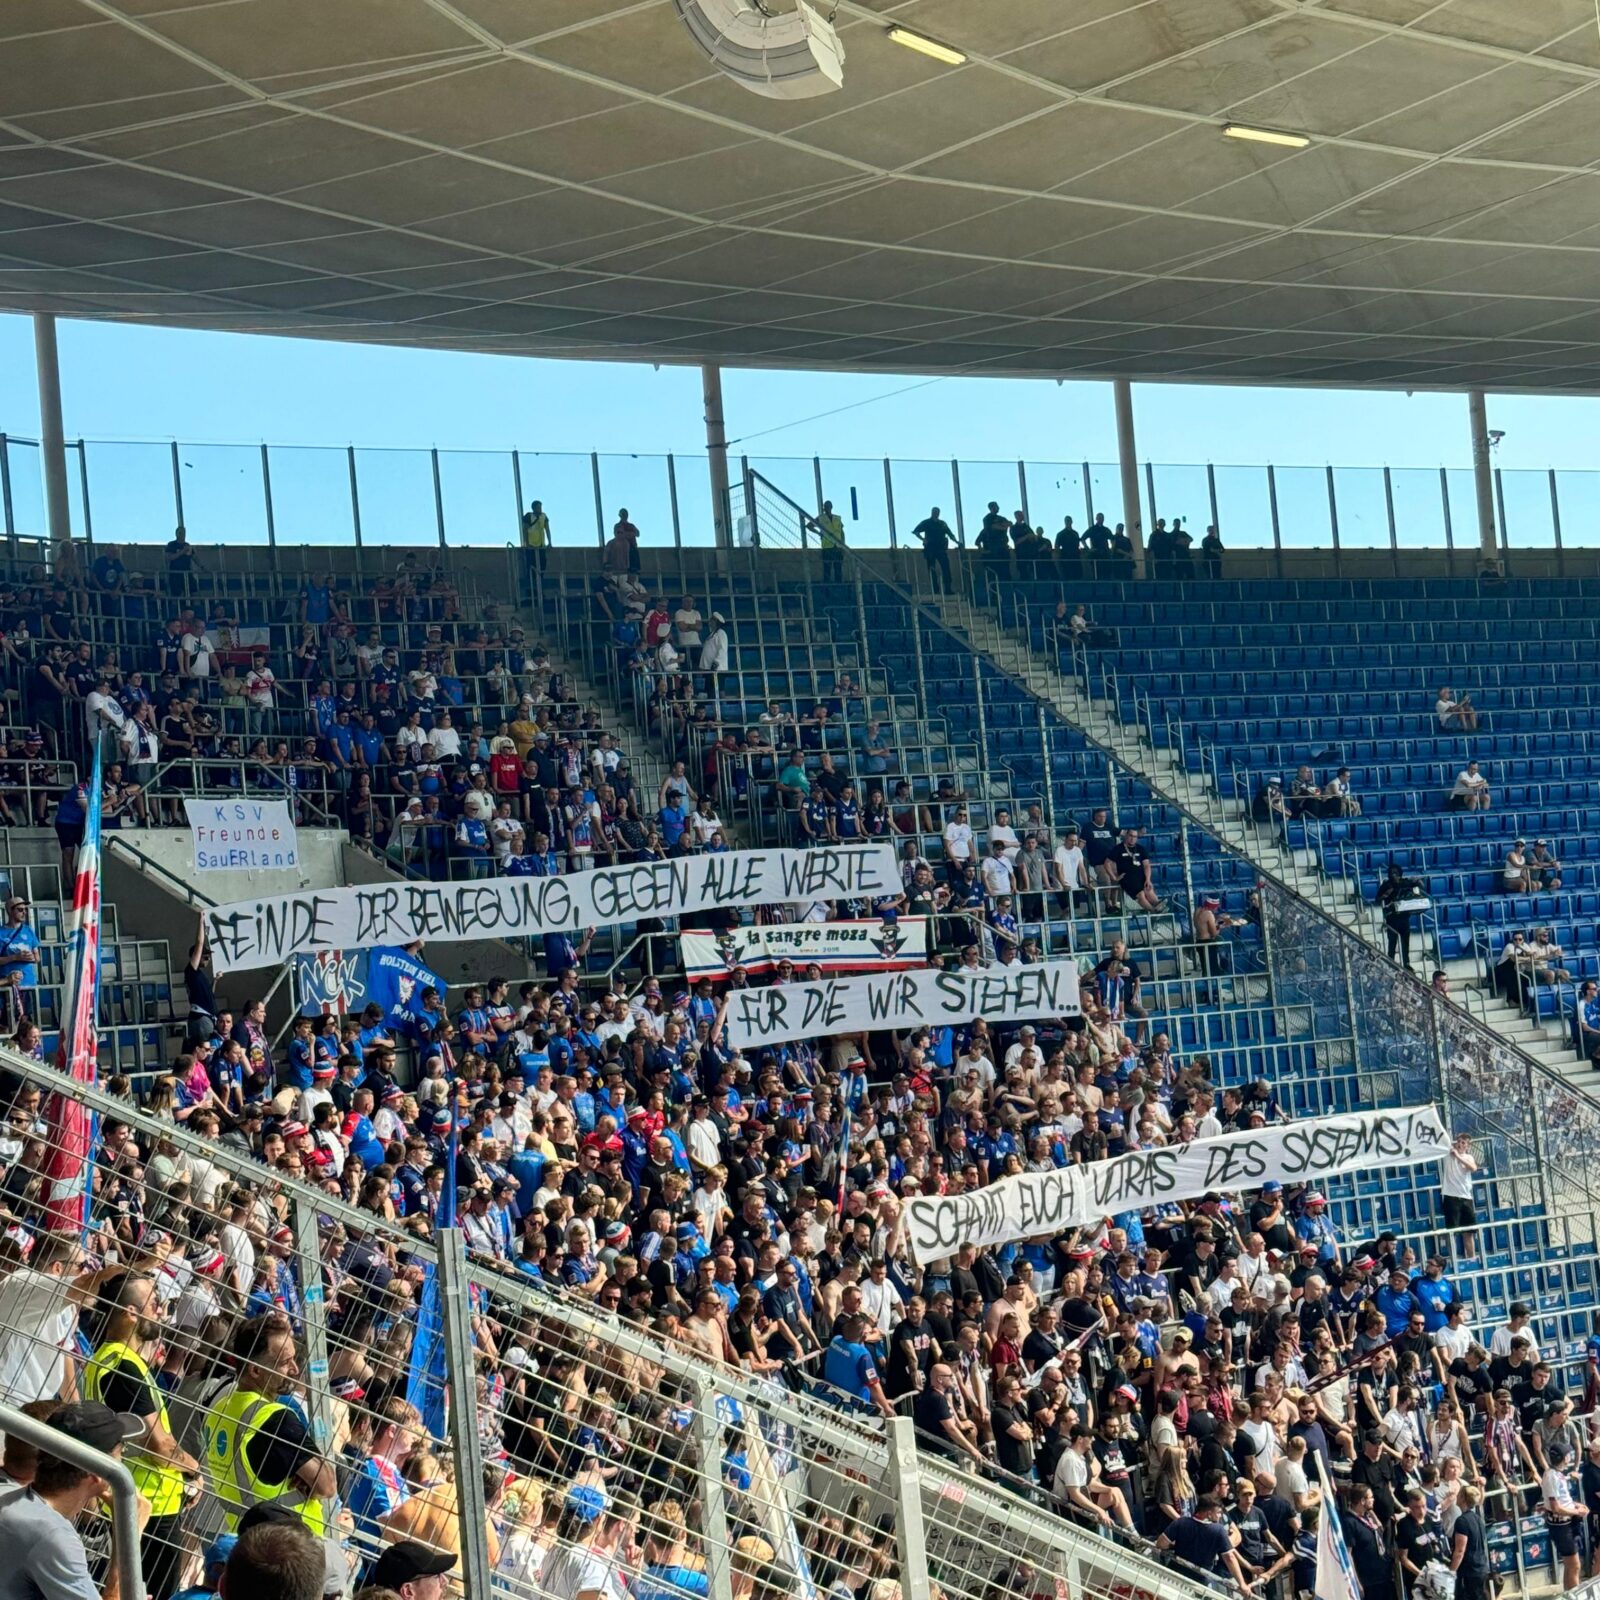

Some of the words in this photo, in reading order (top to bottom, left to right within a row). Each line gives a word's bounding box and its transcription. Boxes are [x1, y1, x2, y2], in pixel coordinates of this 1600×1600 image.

[215, 804, 262, 821] KSV
[197, 826, 280, 842] Freunde
[356, 886, 410, 943] DER
[591, 861, 689, 918] GEGEN
[700, 857, 766, 903] ALLE
[781, 848, 884, 897] WERTE
[765, 929, 822, 947] sangre
[737, 989, 789, 1038] FÜR
[911, 1186, 1007, 1249] SCHAMT
[1018, 1171, 1075, 1231] EUCH
[1204, 1140, 1268, 1188] DES
